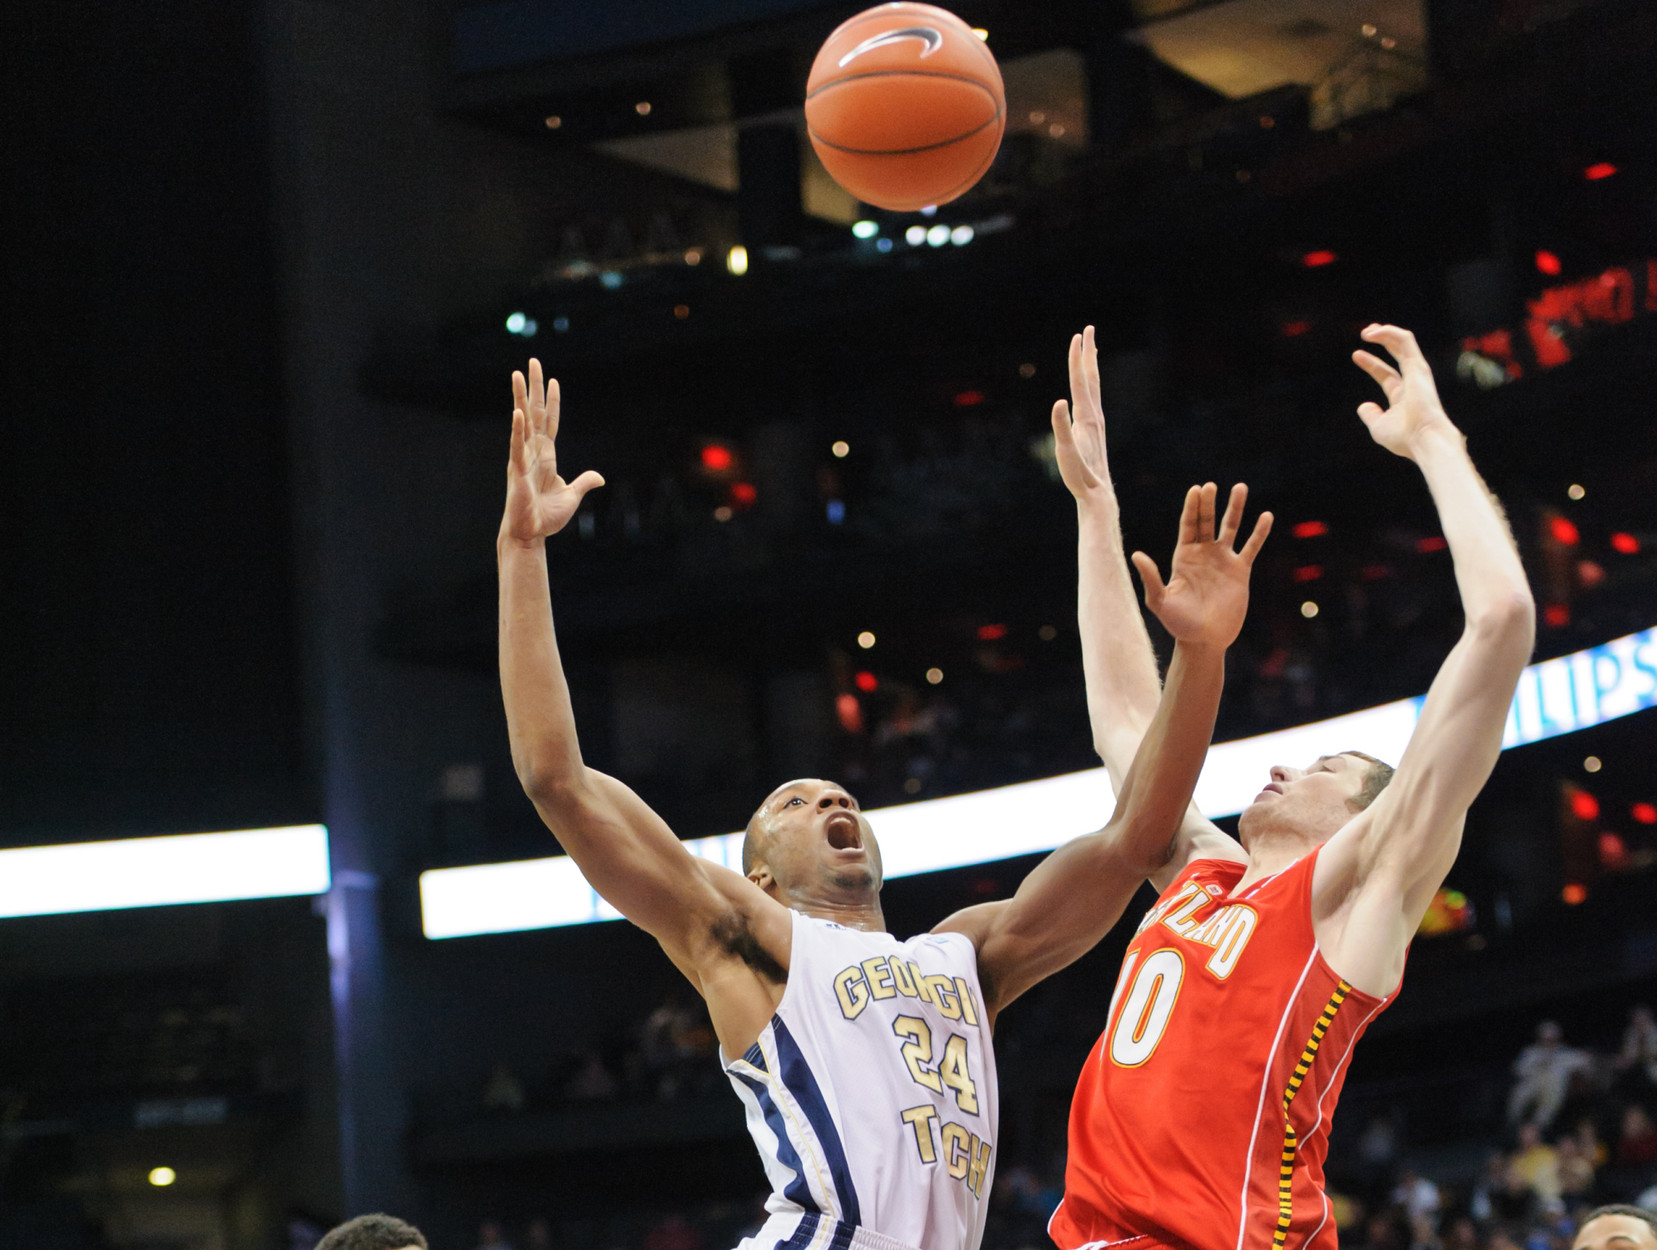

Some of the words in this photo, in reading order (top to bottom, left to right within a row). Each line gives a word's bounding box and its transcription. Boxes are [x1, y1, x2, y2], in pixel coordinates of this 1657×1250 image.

[1100, 946, 1186, 1069] 10
[892, 1013, 980, 1117] 24
[900, 1104, 992, 1201] TCH
